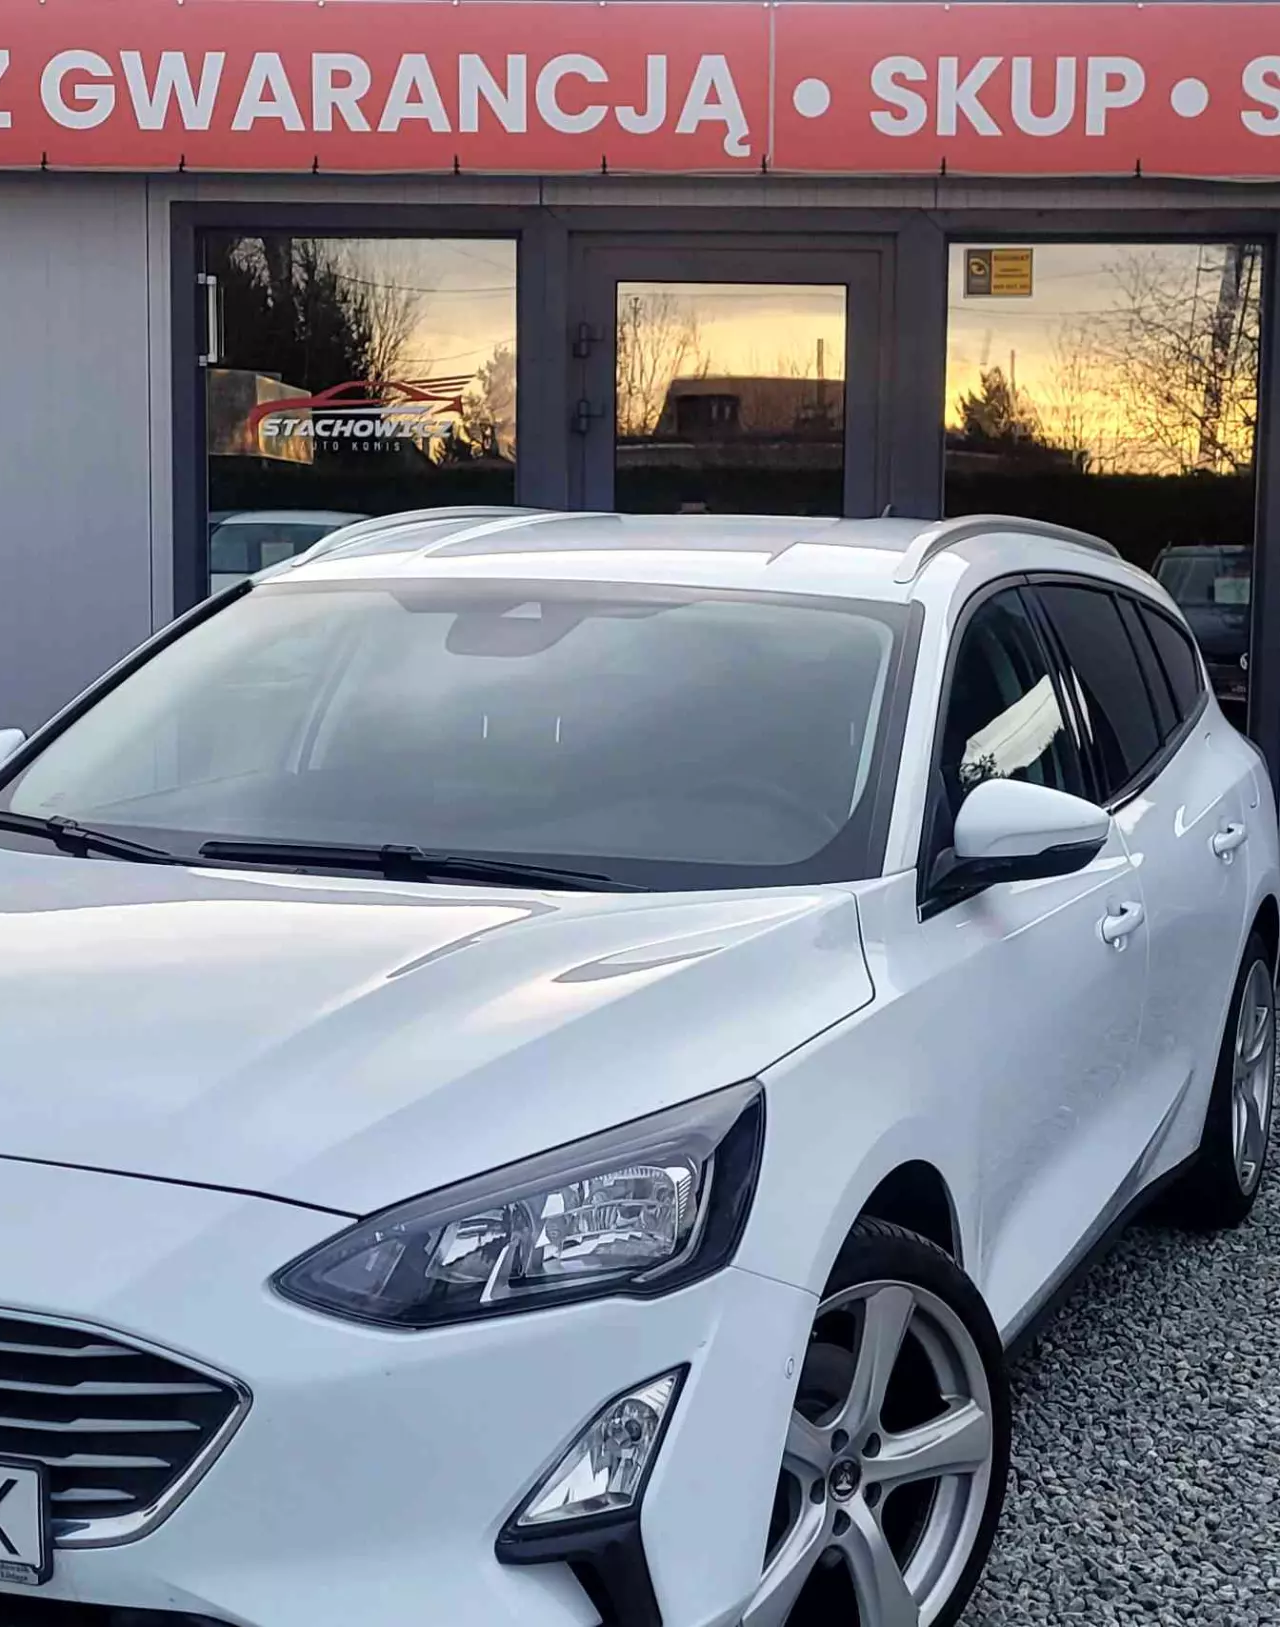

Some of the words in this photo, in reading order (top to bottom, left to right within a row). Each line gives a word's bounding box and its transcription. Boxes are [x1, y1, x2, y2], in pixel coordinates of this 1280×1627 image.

[39, 49, 751, 157] GWARANCJĄ
[869, 55, 1148, 137] SKUP
[263, 418, 453, 438] STACHOWICZ
[352, 441, 401, 452] KOMIS
